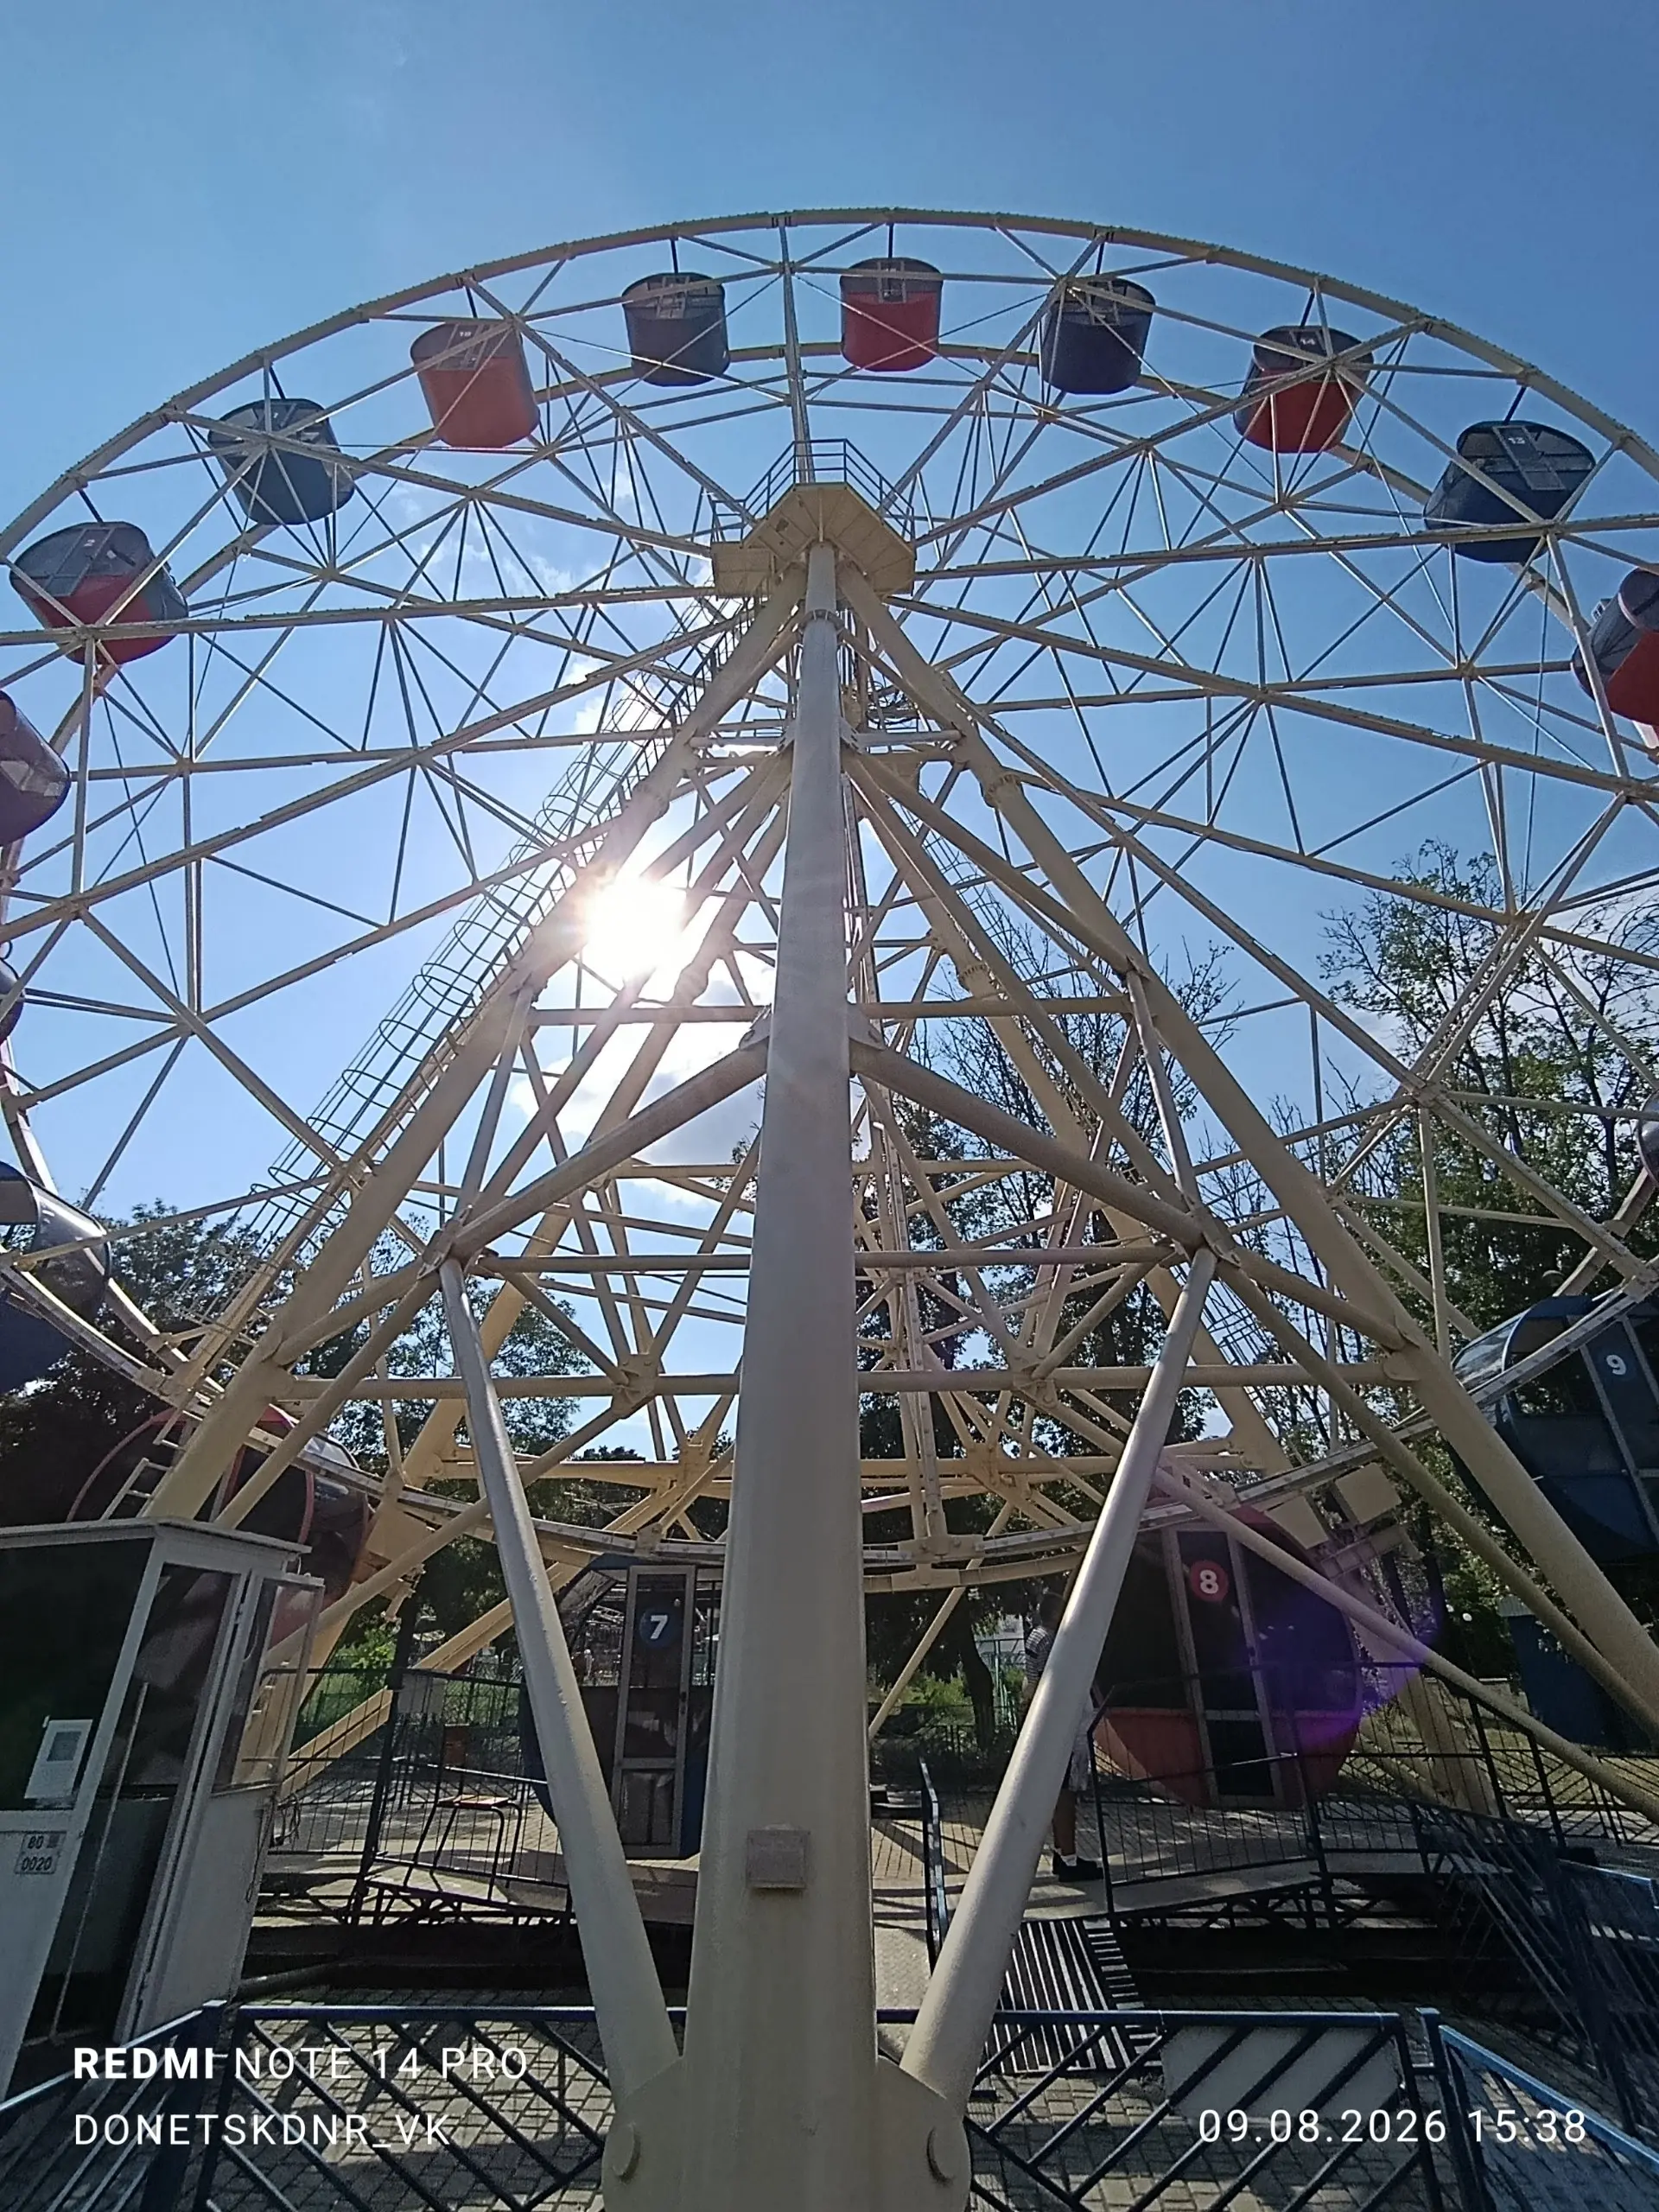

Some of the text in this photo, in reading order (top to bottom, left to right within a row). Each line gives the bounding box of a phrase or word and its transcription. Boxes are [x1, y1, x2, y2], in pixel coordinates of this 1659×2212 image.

[1605, 1354, 1627, 1376] 9
[1199, 1569, 1219, 1594] 8
[650, 1614, 668, 1639] 7
[21, 1856, 53, 1871] 0020
